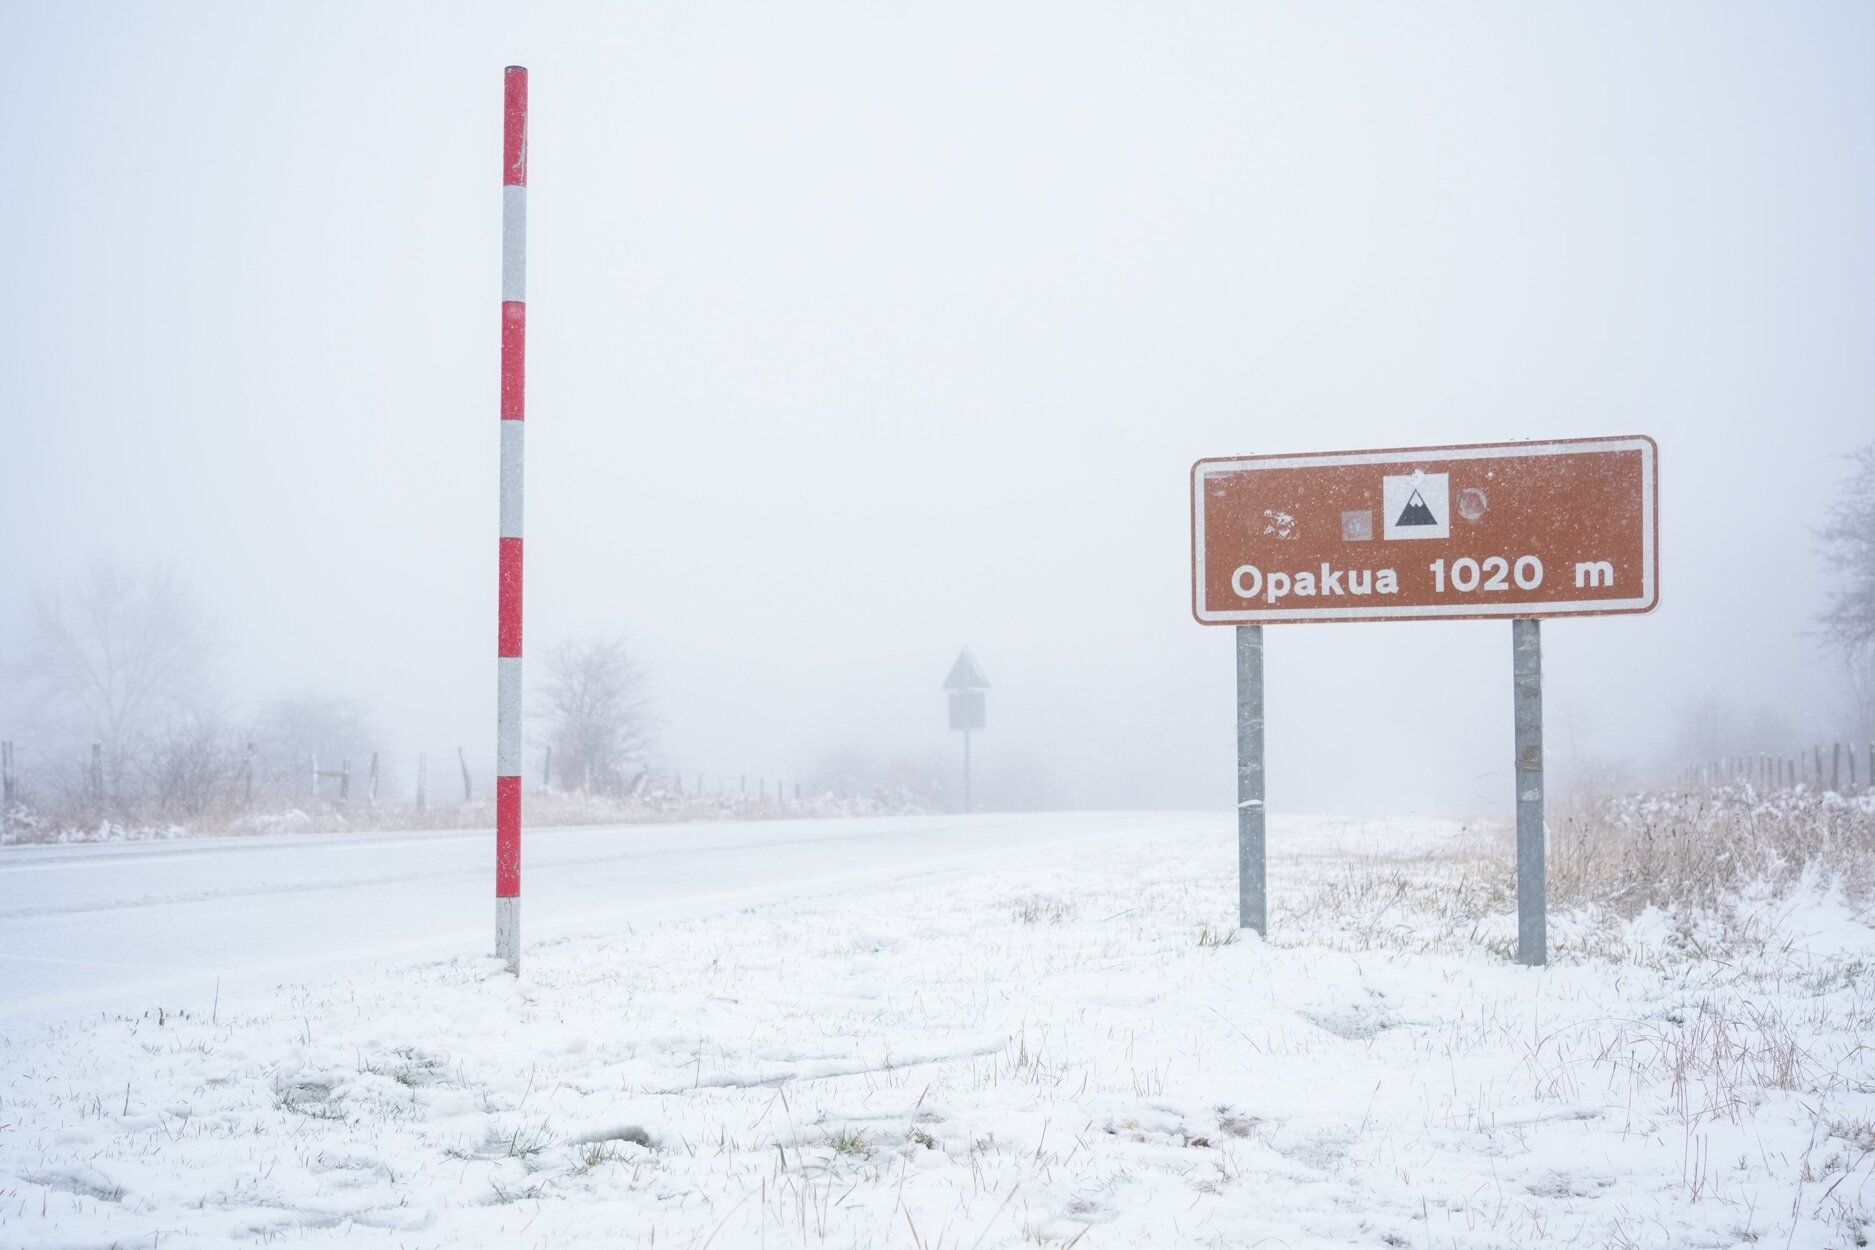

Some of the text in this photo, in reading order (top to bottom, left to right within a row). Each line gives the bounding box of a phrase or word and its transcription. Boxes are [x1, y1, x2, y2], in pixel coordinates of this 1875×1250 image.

[1230, 555, 1614, 604] Opakua 1020 m
